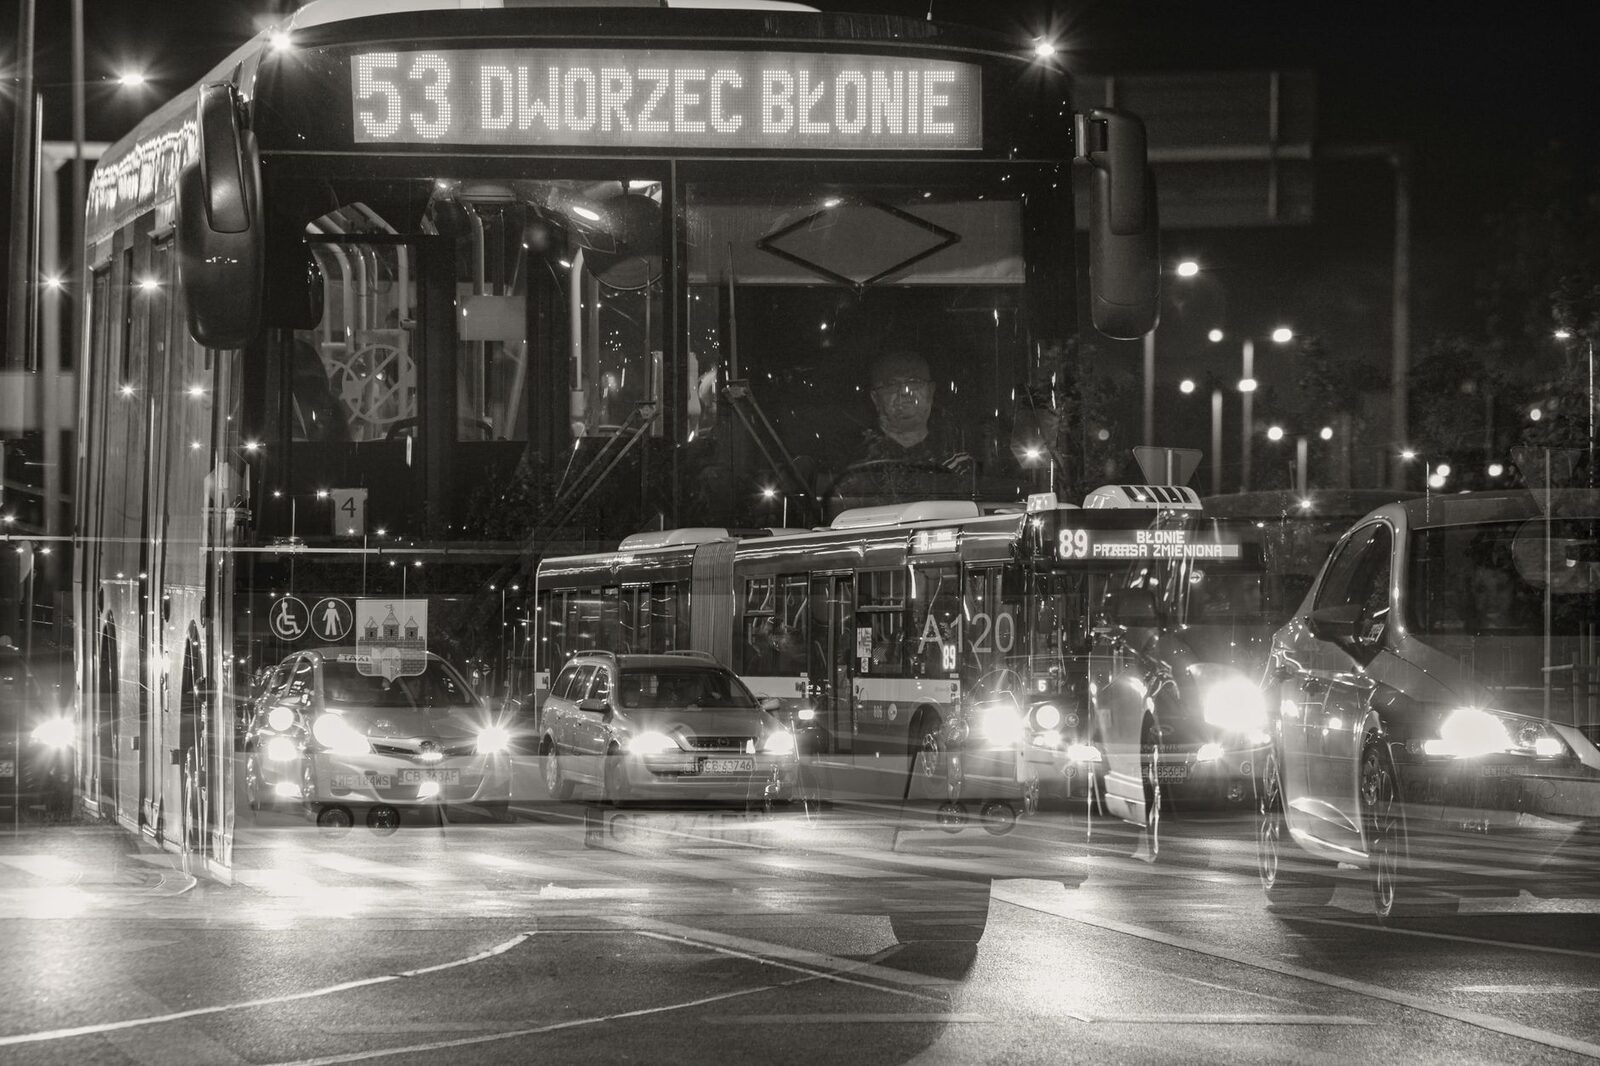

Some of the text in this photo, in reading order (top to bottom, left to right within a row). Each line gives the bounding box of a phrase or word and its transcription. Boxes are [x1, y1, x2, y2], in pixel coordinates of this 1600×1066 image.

[358, 52, 956, 139] 53 DWORZEC BŁONIE
[341, 496, 356, 518] 4
[1059, 529, 1088, 557] 89
[1136, 531, 1185, 544] BŁONIE
[1152, 544, 1222, 557] ZMIENIONA
[917, 612, 1015, 654] A120
[343, 654, 369, 663] TAXI
[942, 644, 957, 670] 89
